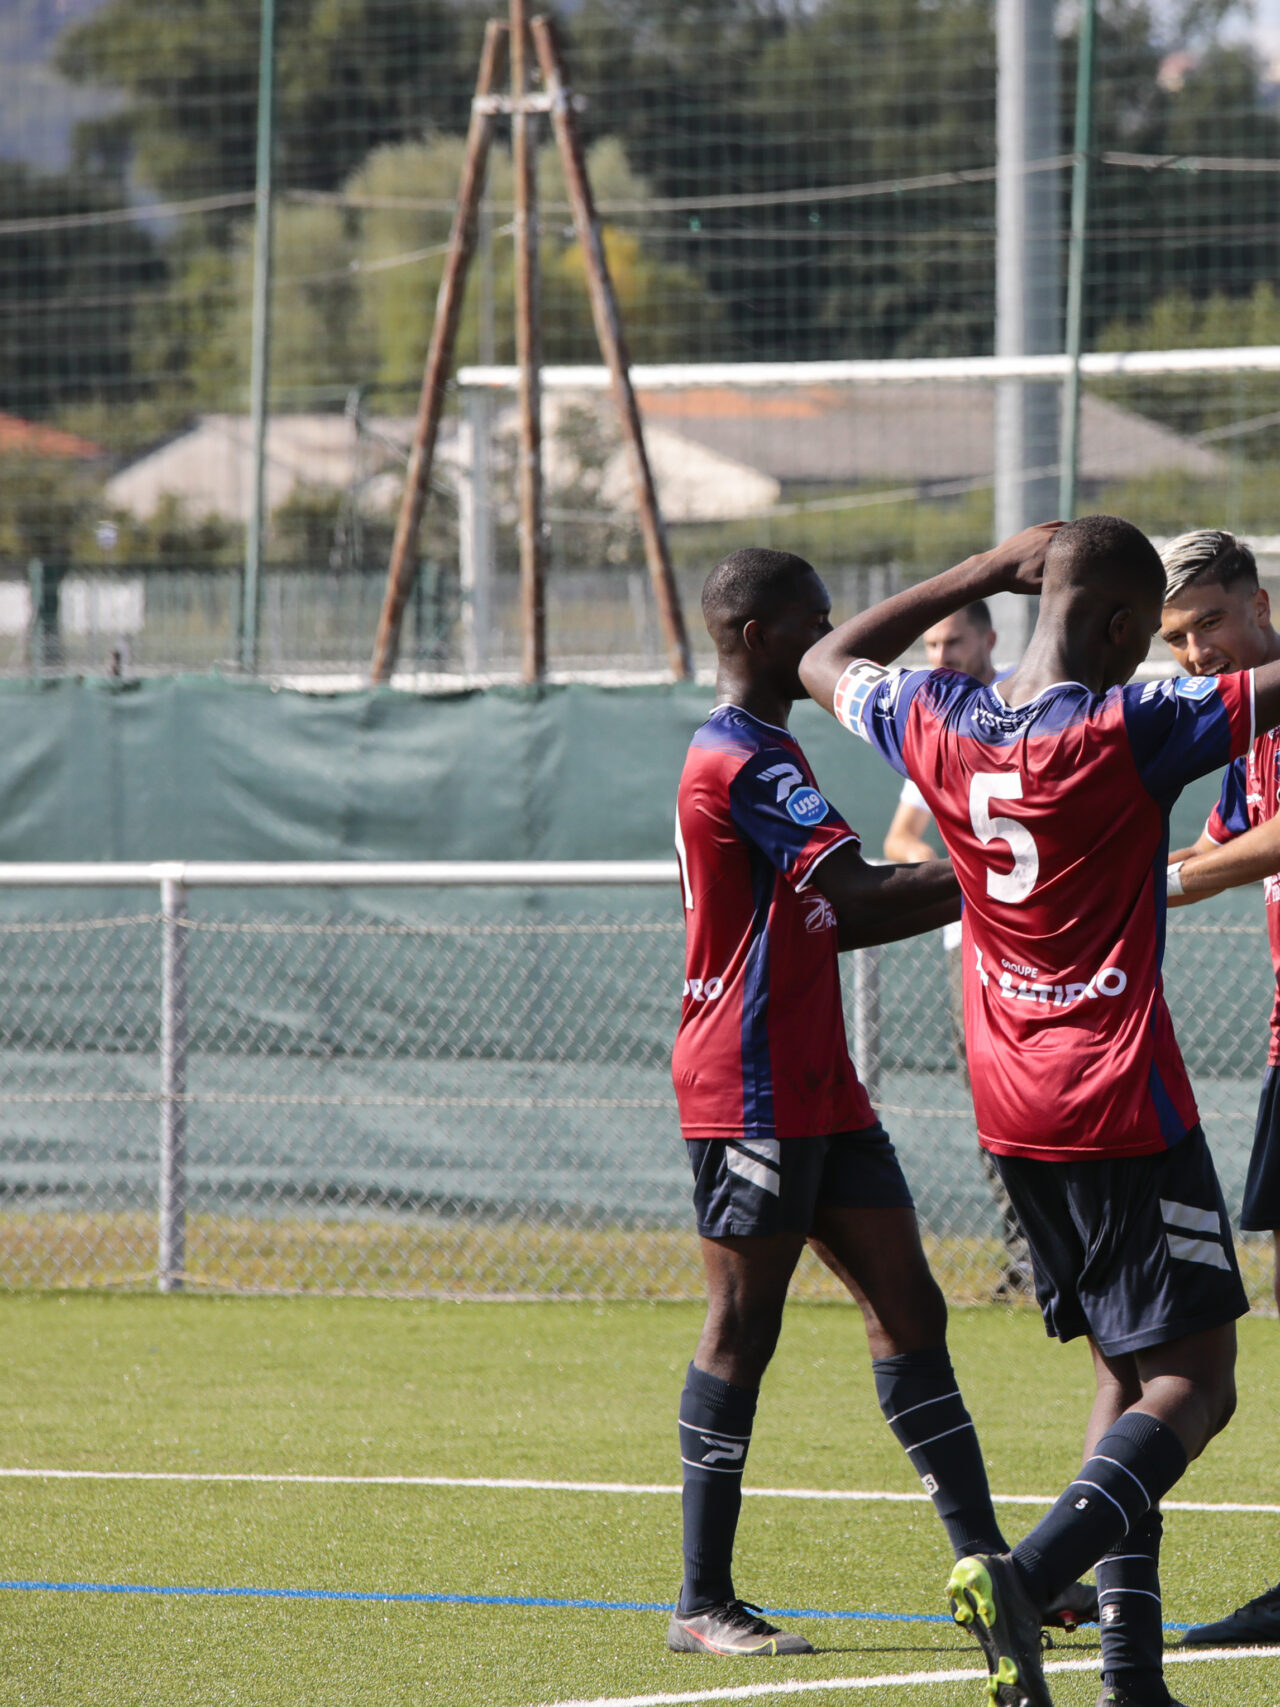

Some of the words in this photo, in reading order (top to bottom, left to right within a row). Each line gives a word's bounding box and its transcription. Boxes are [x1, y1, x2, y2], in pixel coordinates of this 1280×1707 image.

[793, 793, 821, 815] U19
[968, 772, 1039, 904] 5
[1001, 958, 1039, 979] GROUPE
